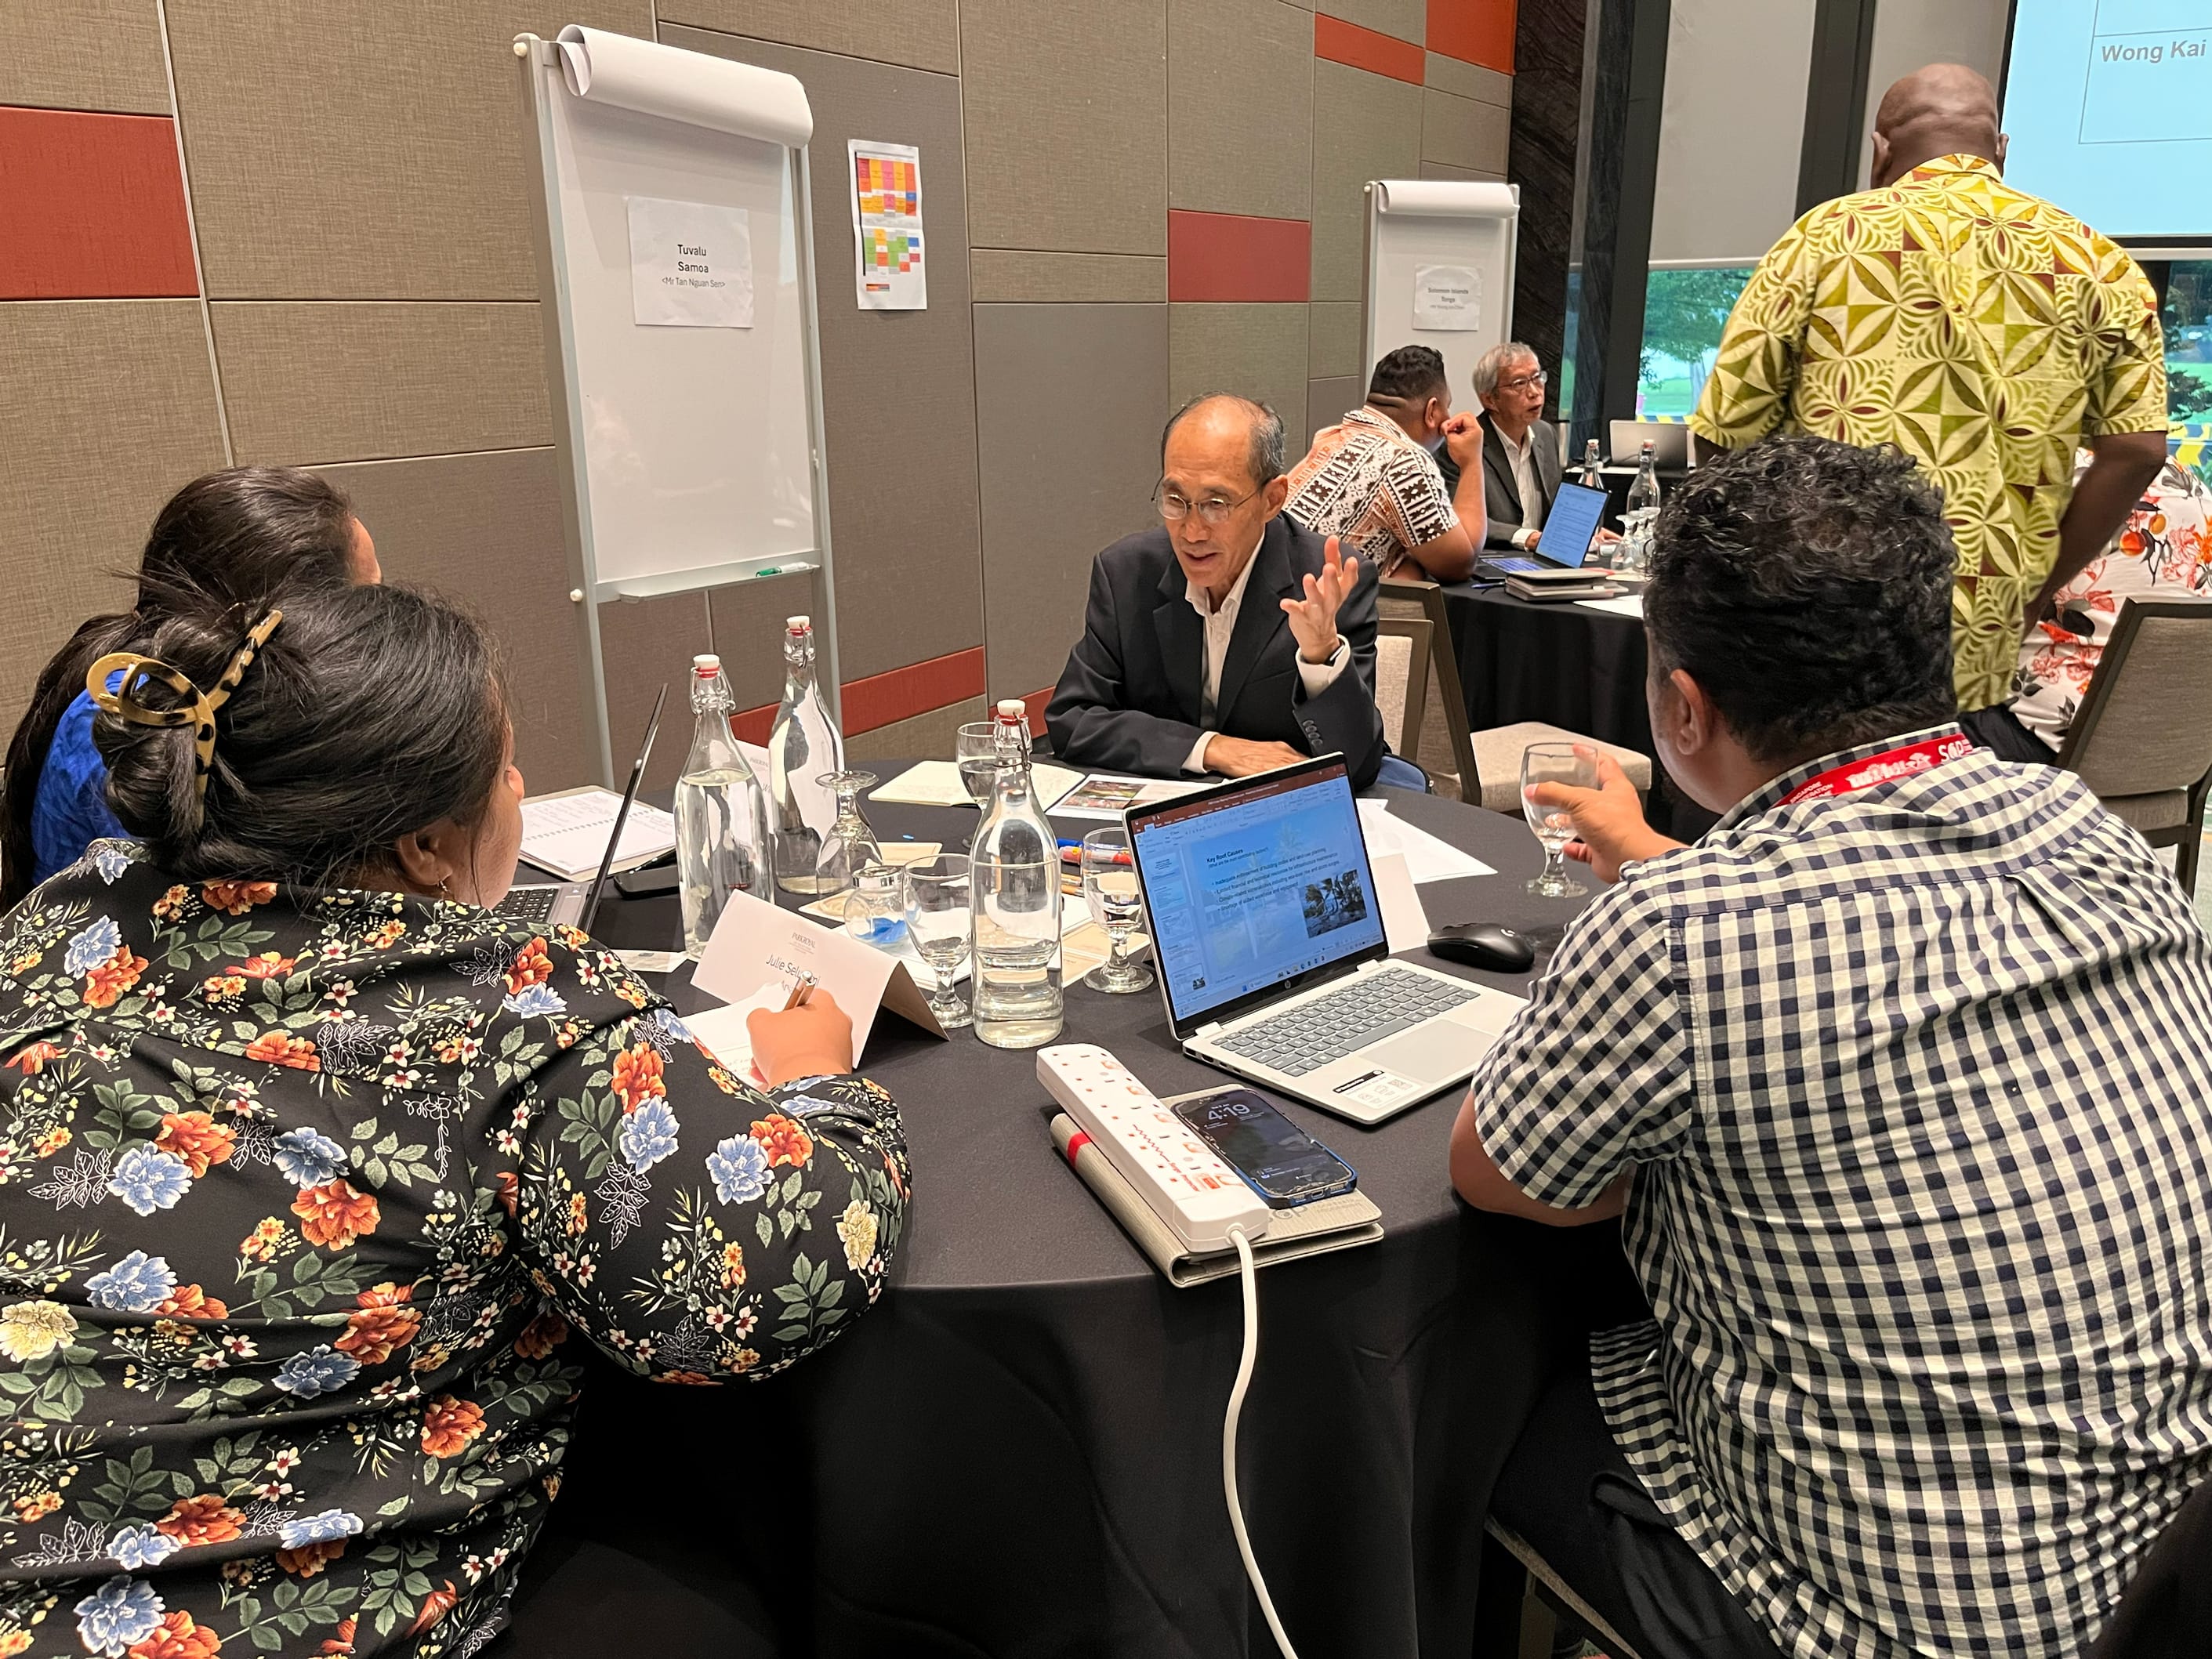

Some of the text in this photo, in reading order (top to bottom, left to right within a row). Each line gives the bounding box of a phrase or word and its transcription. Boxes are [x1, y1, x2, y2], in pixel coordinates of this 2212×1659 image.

[2101, 39, 2207, 63] Wong Kai
[676, 244, 707, 256] Tuvalu
[677, 261, 709, 273] Samoa
[676, 277, 688, 286] Tan
[688, 278, 709, 288] Nguan
[766, 954, 785, 970] Julie
[1208, 1104, 1250, 1121] 4:19
